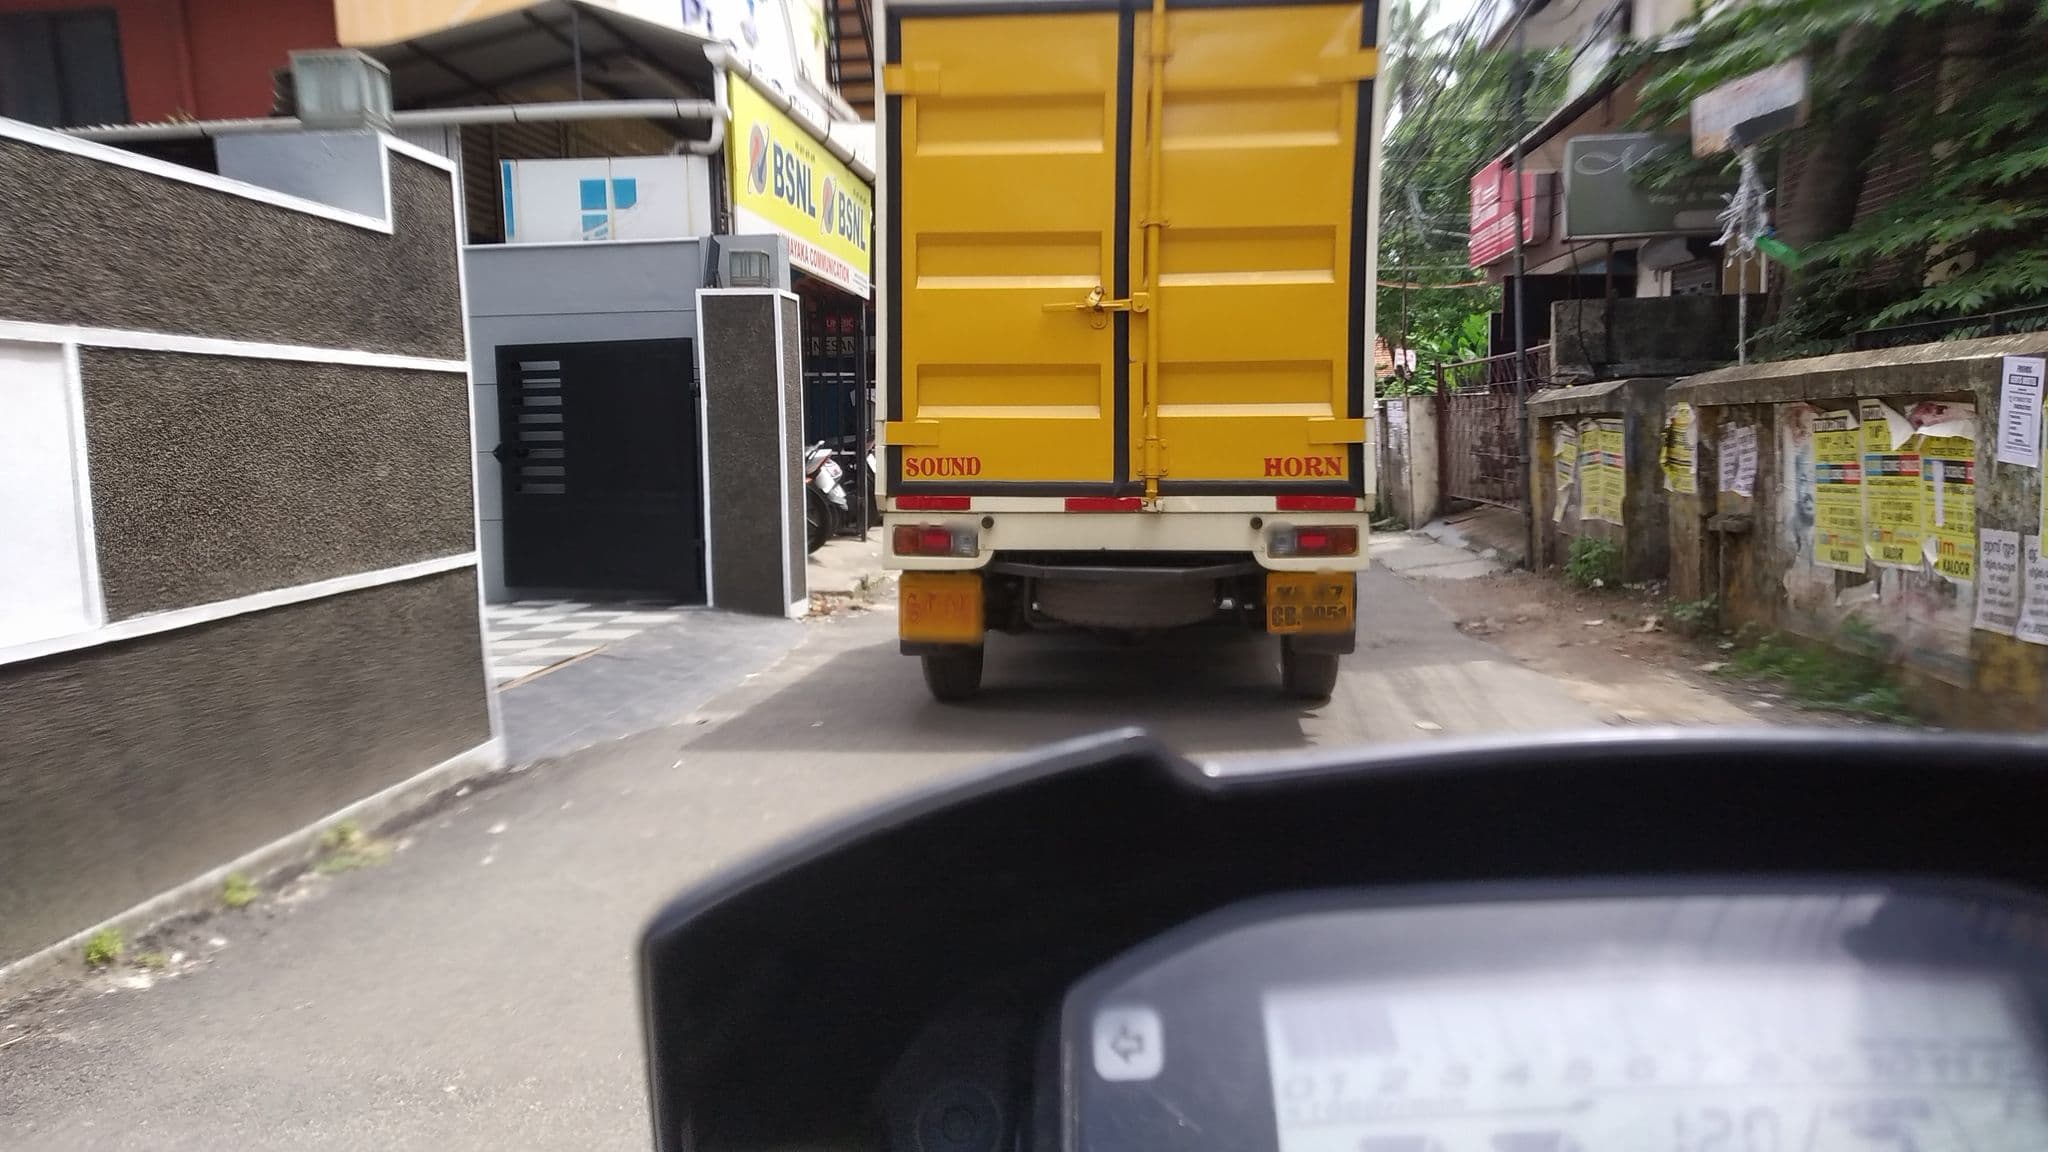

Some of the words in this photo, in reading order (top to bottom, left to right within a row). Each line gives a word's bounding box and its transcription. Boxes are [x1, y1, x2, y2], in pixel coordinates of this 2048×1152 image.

[773, 141, 816, 219] BSNL
[838, 190, 866, 252] BSNL
[787, 237, 809, 262] AYAKA
[905, 456, 982, 477] SOUND
[1263, 456, 1343, 477] HORN
